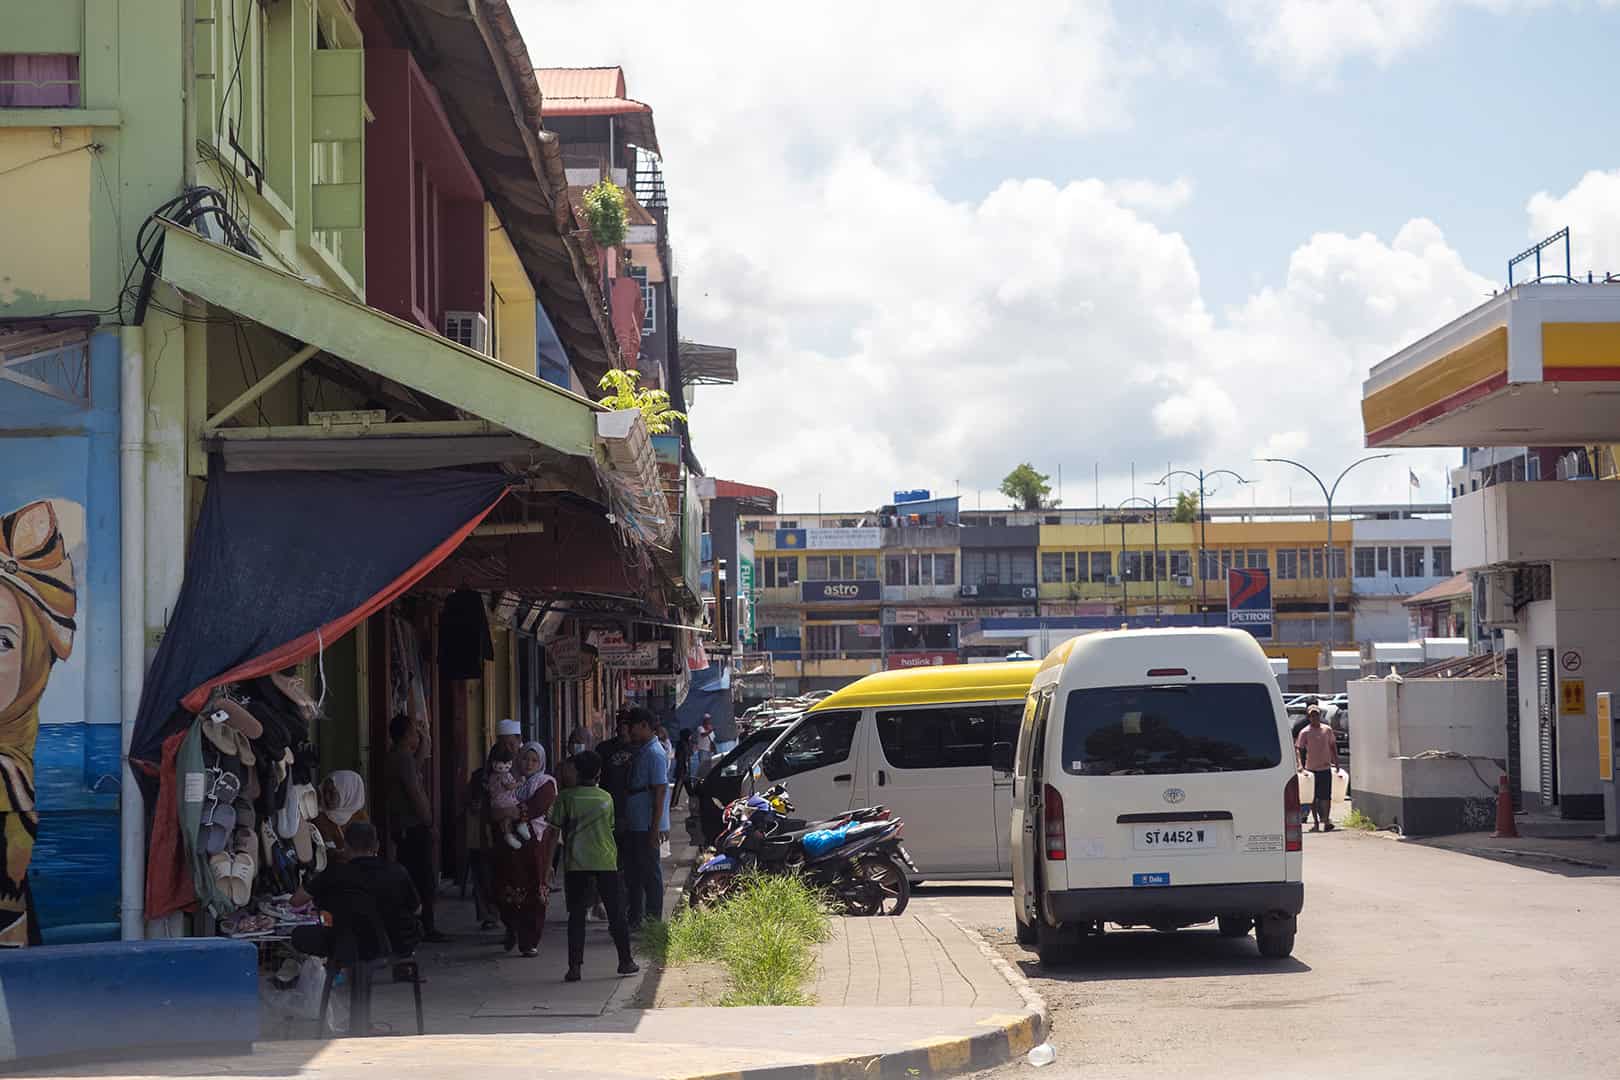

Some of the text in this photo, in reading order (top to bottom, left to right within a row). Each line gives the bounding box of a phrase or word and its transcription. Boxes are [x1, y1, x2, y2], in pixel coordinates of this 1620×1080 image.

[823, 584, 859, 595] astro
[1231, 612, 1270, 622] PETRON
[900, 657, 931, 666] hotlink
[1145, 830, 1204, 844] ST 4452 W
